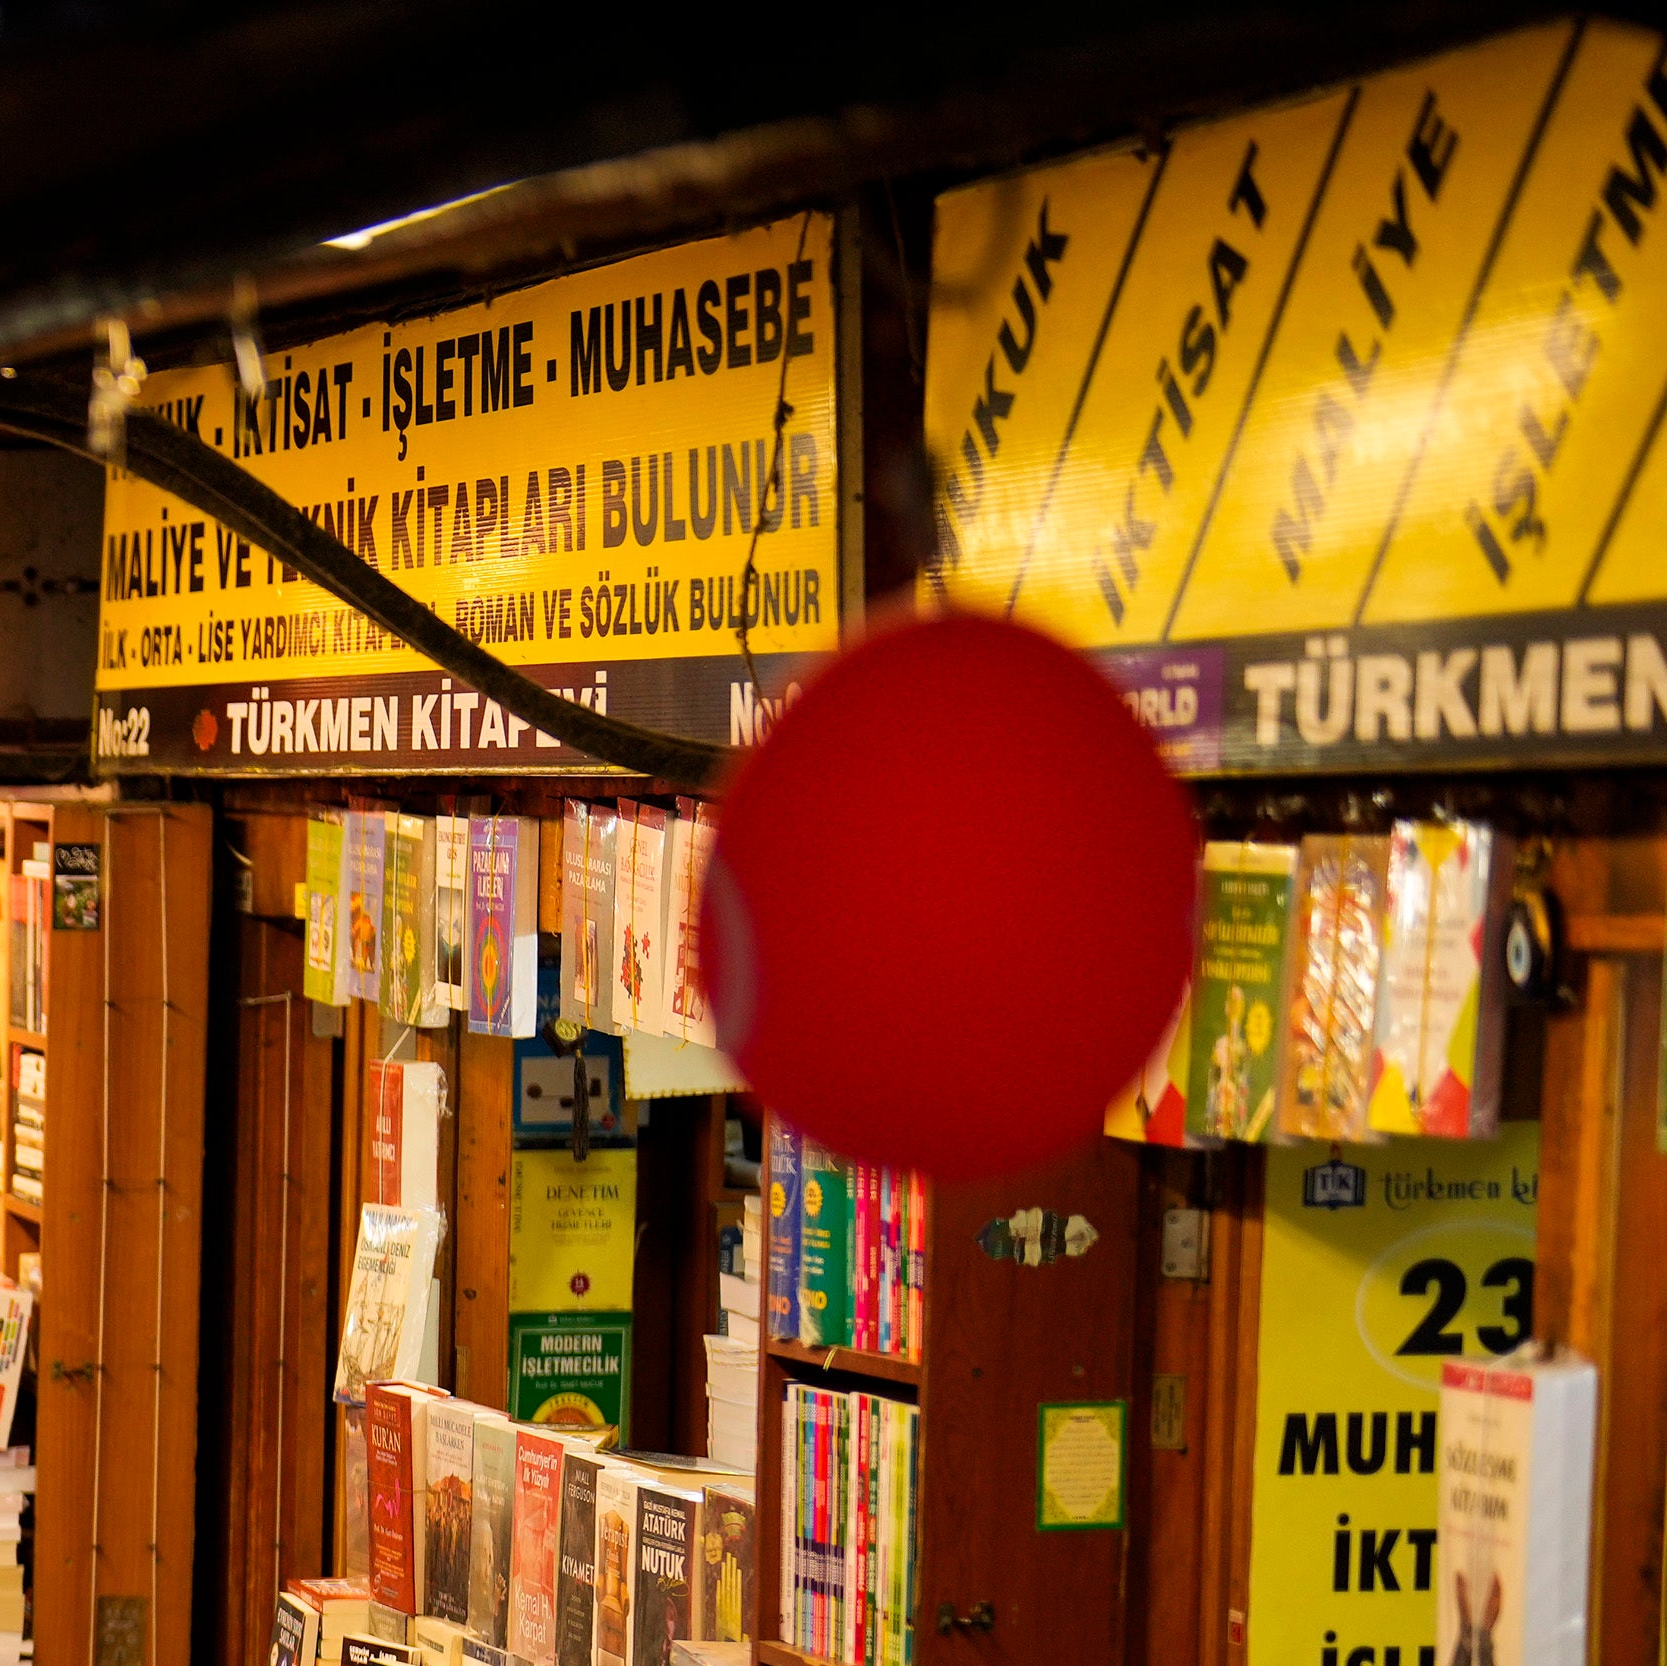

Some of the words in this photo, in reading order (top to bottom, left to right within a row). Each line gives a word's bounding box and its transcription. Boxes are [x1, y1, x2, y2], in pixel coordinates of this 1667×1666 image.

[1267, 87, 1461, 586] MALİYE
[382, 322, 535, 461] İŞLETME
[570, 260, 815, 397] MUHASEBE
[107, 507, 205, 600] MALİYE
[216, 523, 251, 589] VE
[391, 465, 586, 570] KİTAPLARI
[602, 433, 819, 549] BULUNUR
[103, 621, 126, 670] İLK
[141, 623, 182, 668] ORTA
[198, 610, 234, 663] LİSE
[240, 610, 327, 659] YARDIMCI
[543, 588, 572, 640] VE
[580, 566, 680, 639] SÖZLÜK
[689, 568, 820, 631] BULUNUR
[227, 686, 399, 756] TÜRKMEN
[1394, 1258, 1535, 1357] 23
[540, 1334, 602, 1354] MODERN
[522, 1353, 620, 1379] İŞLETMECİLİK
[371, 1422, 402, 1453] KUR'AN
[643, 1512, 686, 1542] ATATÜRK
[562, 1555, 596, 1586] KIYAMET
[642, 1545, 685, 1582] NUTUK
[515, 1583, 540, 1617] Kemal
[518, 1615, 547, 1645] Karpat
